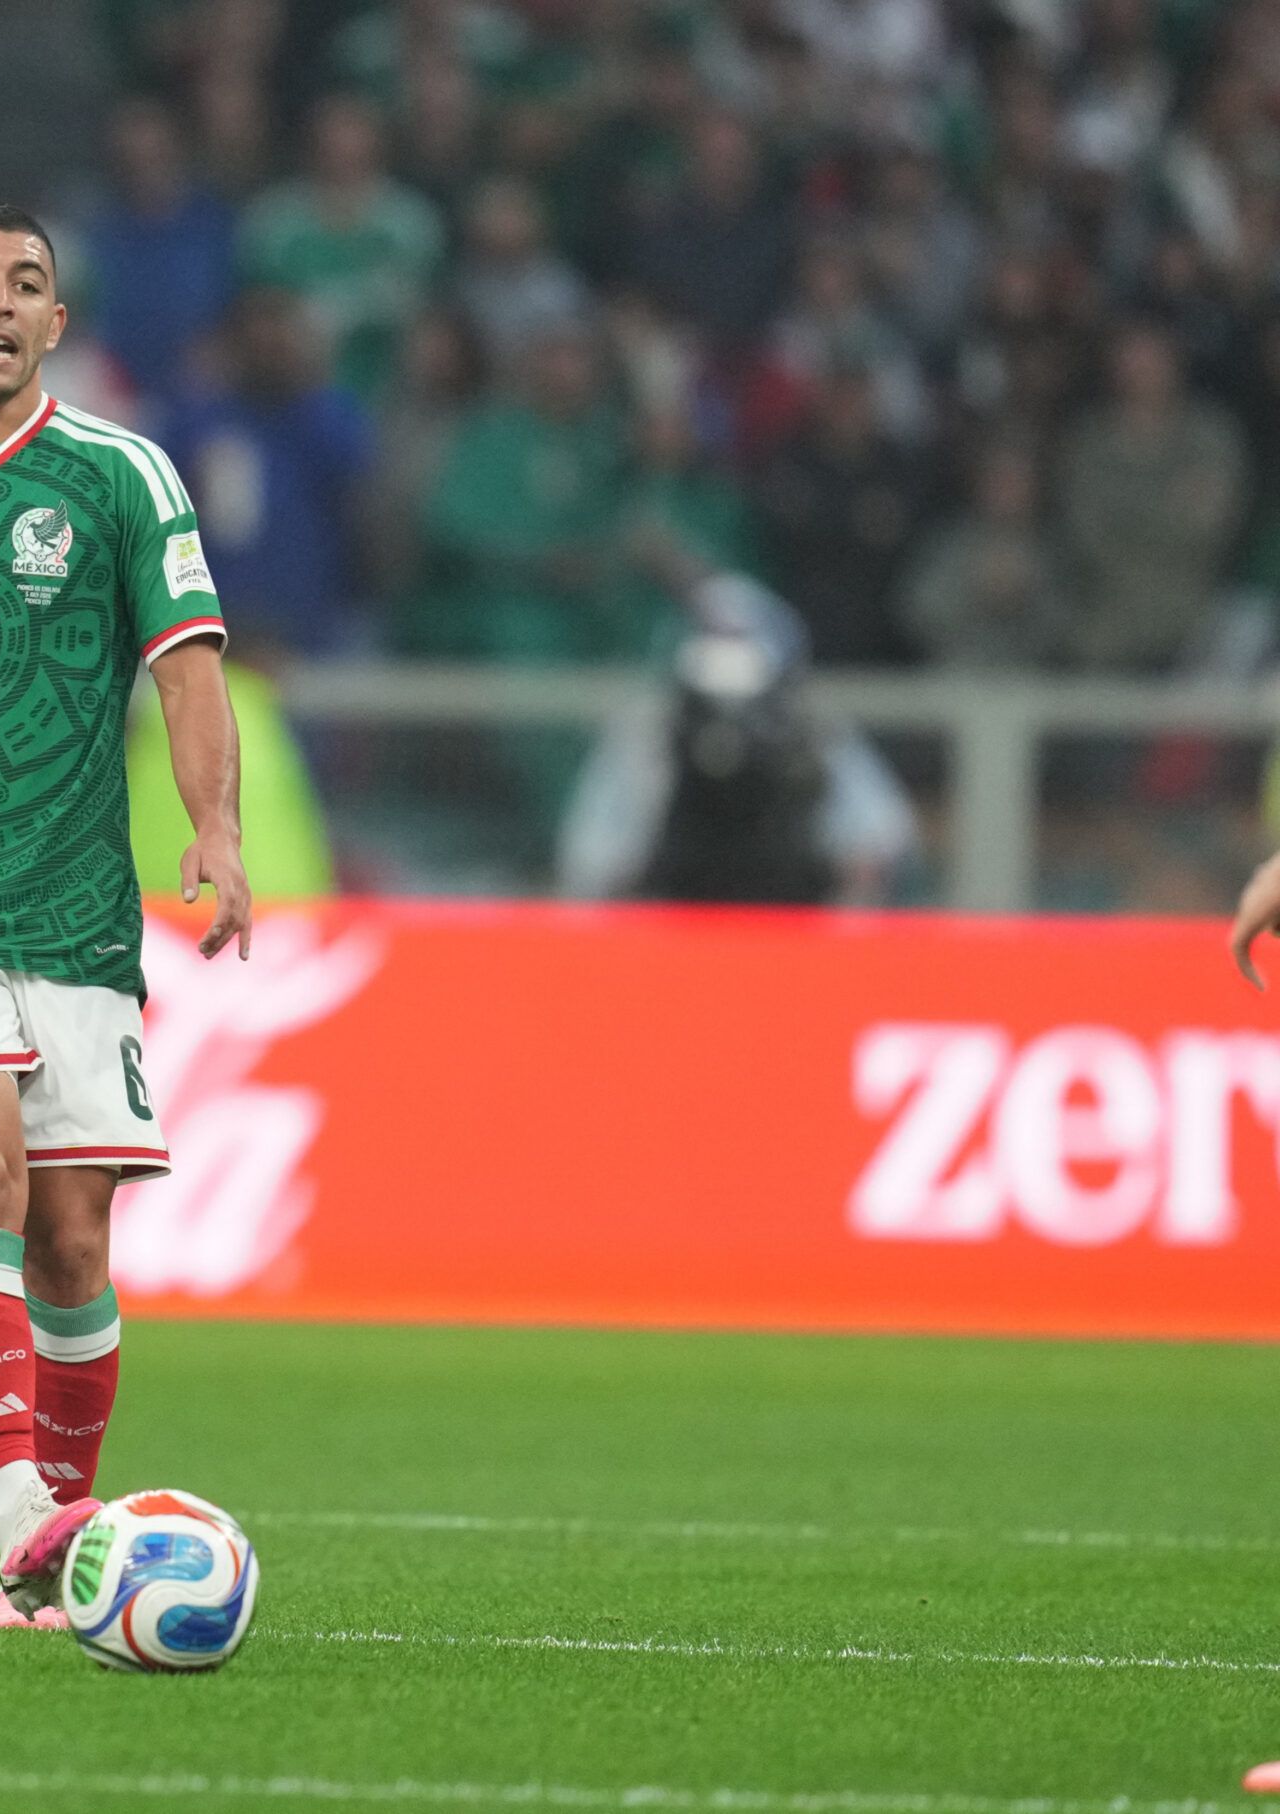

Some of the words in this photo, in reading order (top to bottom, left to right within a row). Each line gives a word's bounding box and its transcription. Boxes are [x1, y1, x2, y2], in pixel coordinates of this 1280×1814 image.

[14, 560, 66, 575] MÉXICO
[120, 1034, 154, 1121] 6
[846, 1020, 1280, 1247] zer
